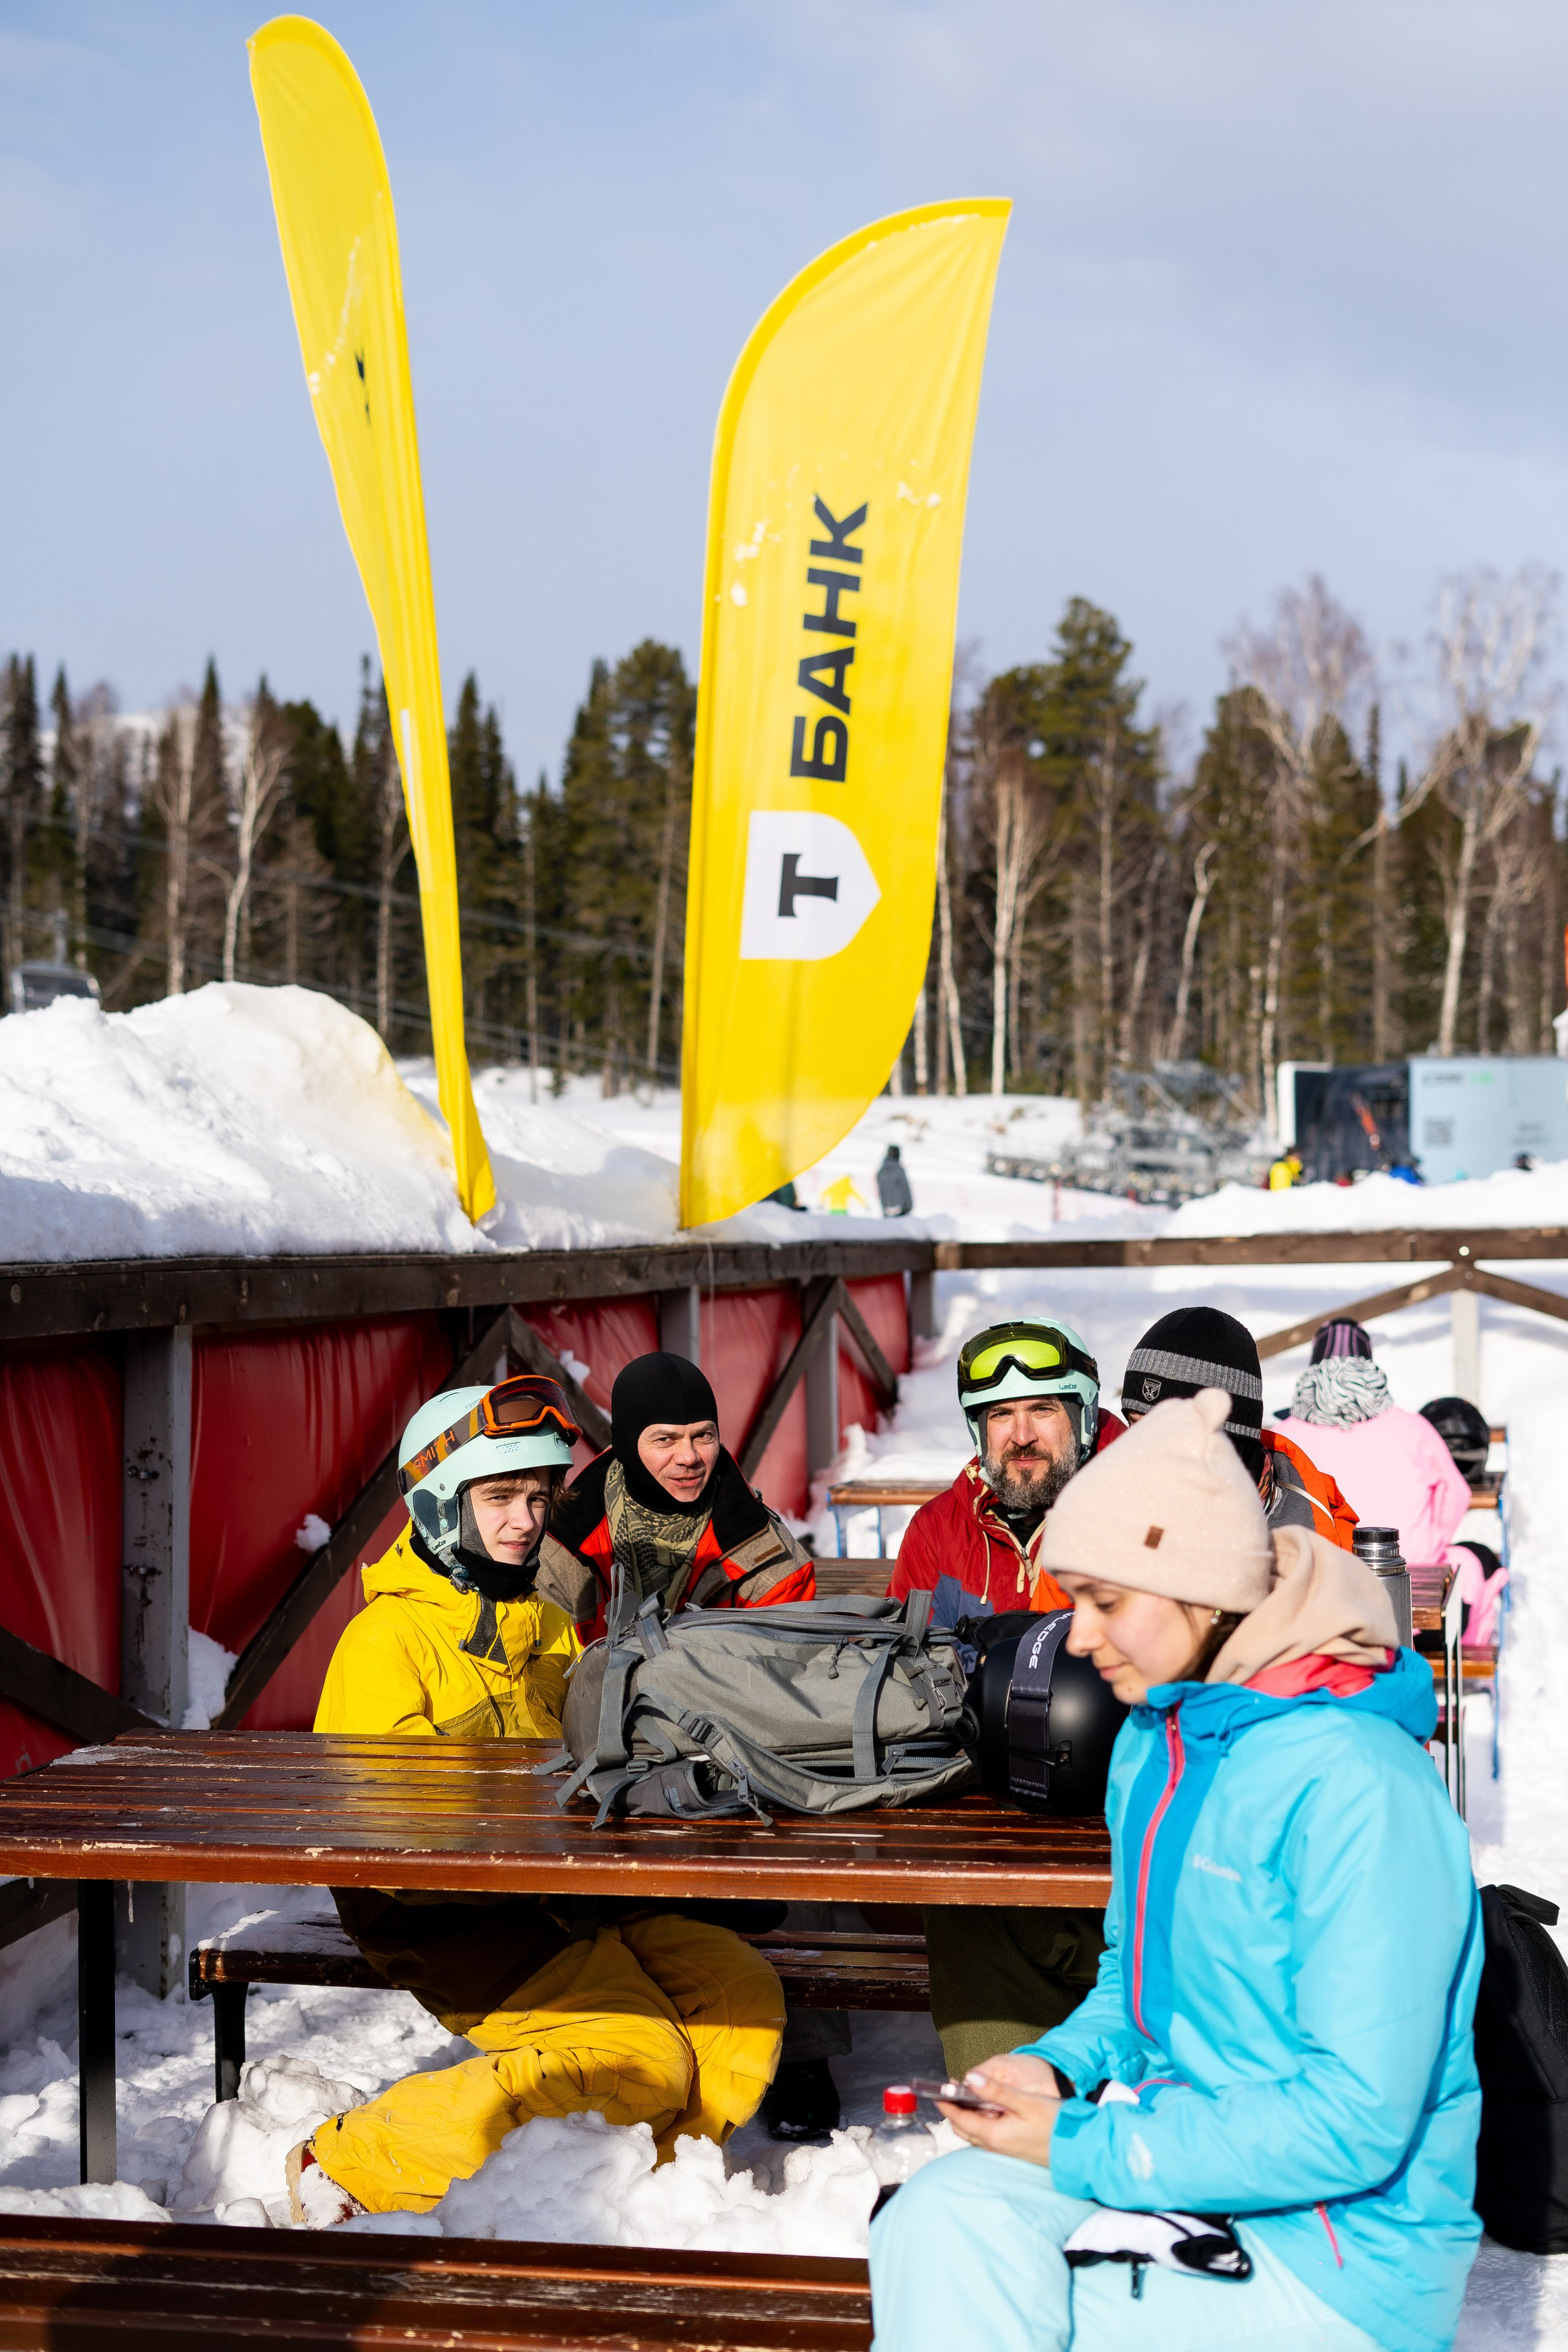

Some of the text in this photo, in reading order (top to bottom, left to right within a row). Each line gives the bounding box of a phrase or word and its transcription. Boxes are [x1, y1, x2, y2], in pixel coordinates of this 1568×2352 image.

[790, 493, 869, 783] БАНК
[413, 1430, 455, 1471] SMITH
[1028, 1611, 1076, 1669] WLEDGE
